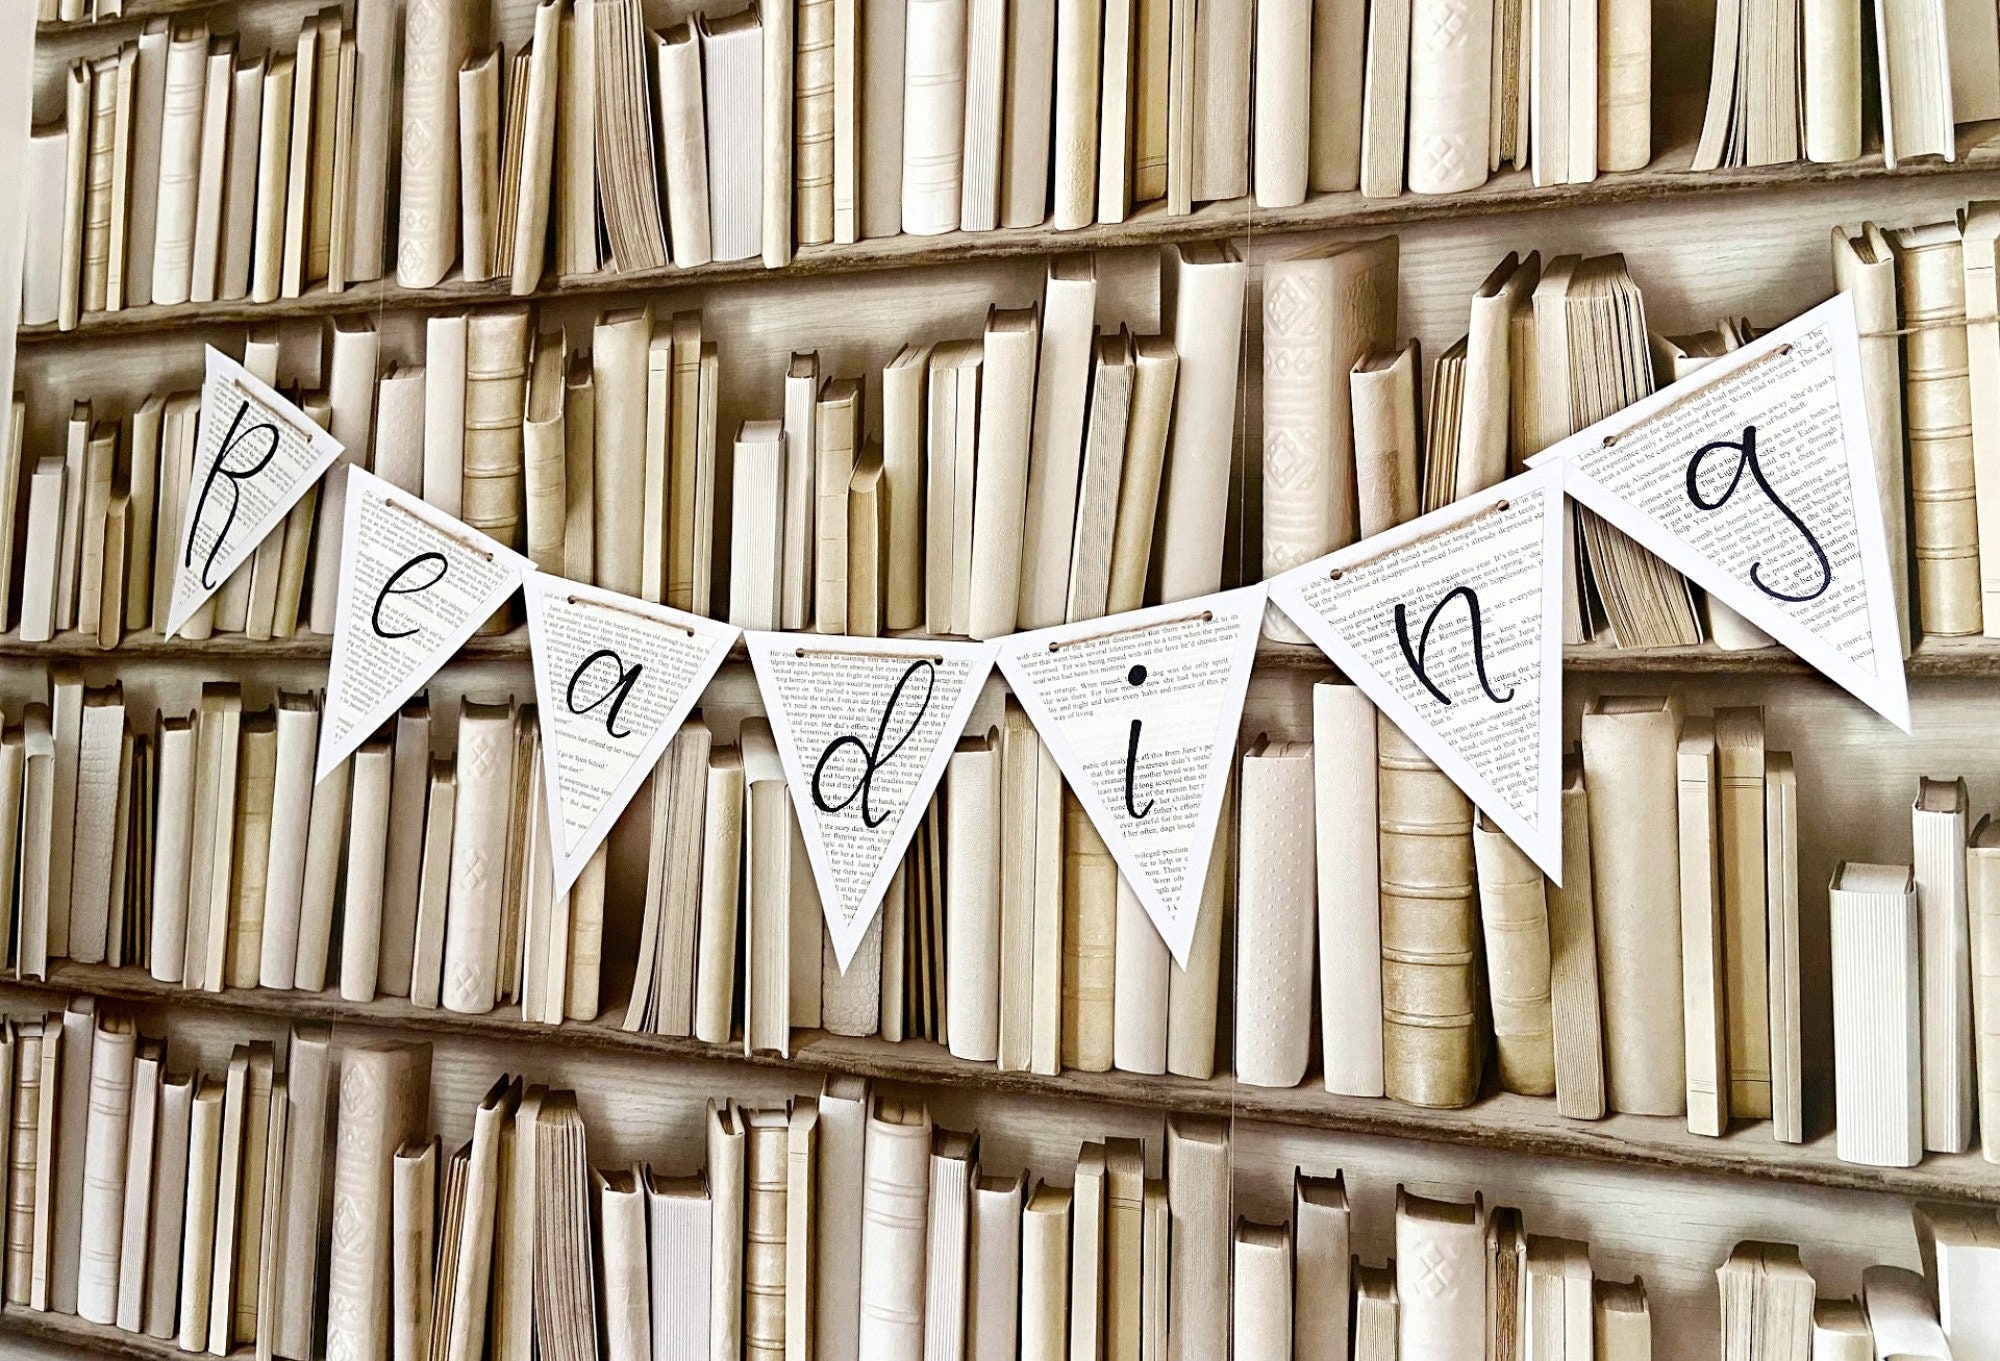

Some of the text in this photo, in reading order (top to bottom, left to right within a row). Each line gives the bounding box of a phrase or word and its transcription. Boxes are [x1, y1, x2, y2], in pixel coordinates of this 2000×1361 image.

[1609, 434, 1648, 457] responsible
[1650, 427, 1661, 436] for
[1662, 420, 1674, 429] the
[1674, 411, 1692, 422] love
[1692, 399, 1712, 413] bond
[1712, 391, 1727, 403] had
[1728, 385, 1741, 395] not
[1741, 375, 1760, 387] been
[1798, 346, 1813, 358] The
[1815, 338, 1829, 350] girl
[1602, 449, 1640, 472] experience
[1640, 441, 1657, 452] only
[1664, 426, 1683, 440] short
[1683, 418, 1701, 429] time
[1702, 410, 1710, 420] of
[1730, 391, 1752, 404] Wren
[1752, 381, 1767, 393] had
[1800, 357, 1818, 368] This
[1632, 461, 1671, 484] Alessandro
[1734, 412, 1767, 431] lifetimes
[1814, 379, 1829, 390] just
[1648, 414, 1841, 515] struggling The safer than Earth even
[1690, 475, 1824, 545] womb for home something
[1320, 587, 1331, 595] she
[1334, 578, 1354, 590] shook
[1355, 573, 1366, 582] her
[1367, 565, 1385, 577] head
[1387, 560, 1399, 569] and
[1422, 544, 1438, 554] with
[1439, 539, 1451, 548] her
[1453, 530, 1477, 542] tongue
[1478, 517, 1503, 532] behind
[1504, 513, 1517, 522] her
[1518, 504, 1536, 516] teeth
[1321, 597, 1332, 605] the
[1333, 589, 1352, 601] sharp
[1353, 582, 1371, 593] noise
[1372, 577, 1380, 585] of
[1381, 561, 1420, 582] disapproval
[1421, 551, 1447, 568] pierced
[1471, 532, 1496, 546] already
[1498, 515, 1533, 535] depressed
[1069, 652, 1084, 661] back
[1086, 647, 1107, 657] several
[1109, 644, 1136, 653] lifetimes
[1144, 648, 1152, 656] all
[1426, 627, 1535, 672] every cotton which June
[812, 670, 834, 678] perhaps
[1195, 661, 1209, 669] only
[1518, 666, 1530, 674] the
[1443, 695, 1479, 714] pass them
[1453, 725, 1468, 735] into
[1514, 700, 1534, 711] wool
[1460, 714, 1527, 742] before she tugged
[1480, 726, 1525, 746] compressing
[1139, 771, 1162, 780] mother
[1163, 767, 1181, 776] loved
[1155, 776, 1183, 787] accepted
